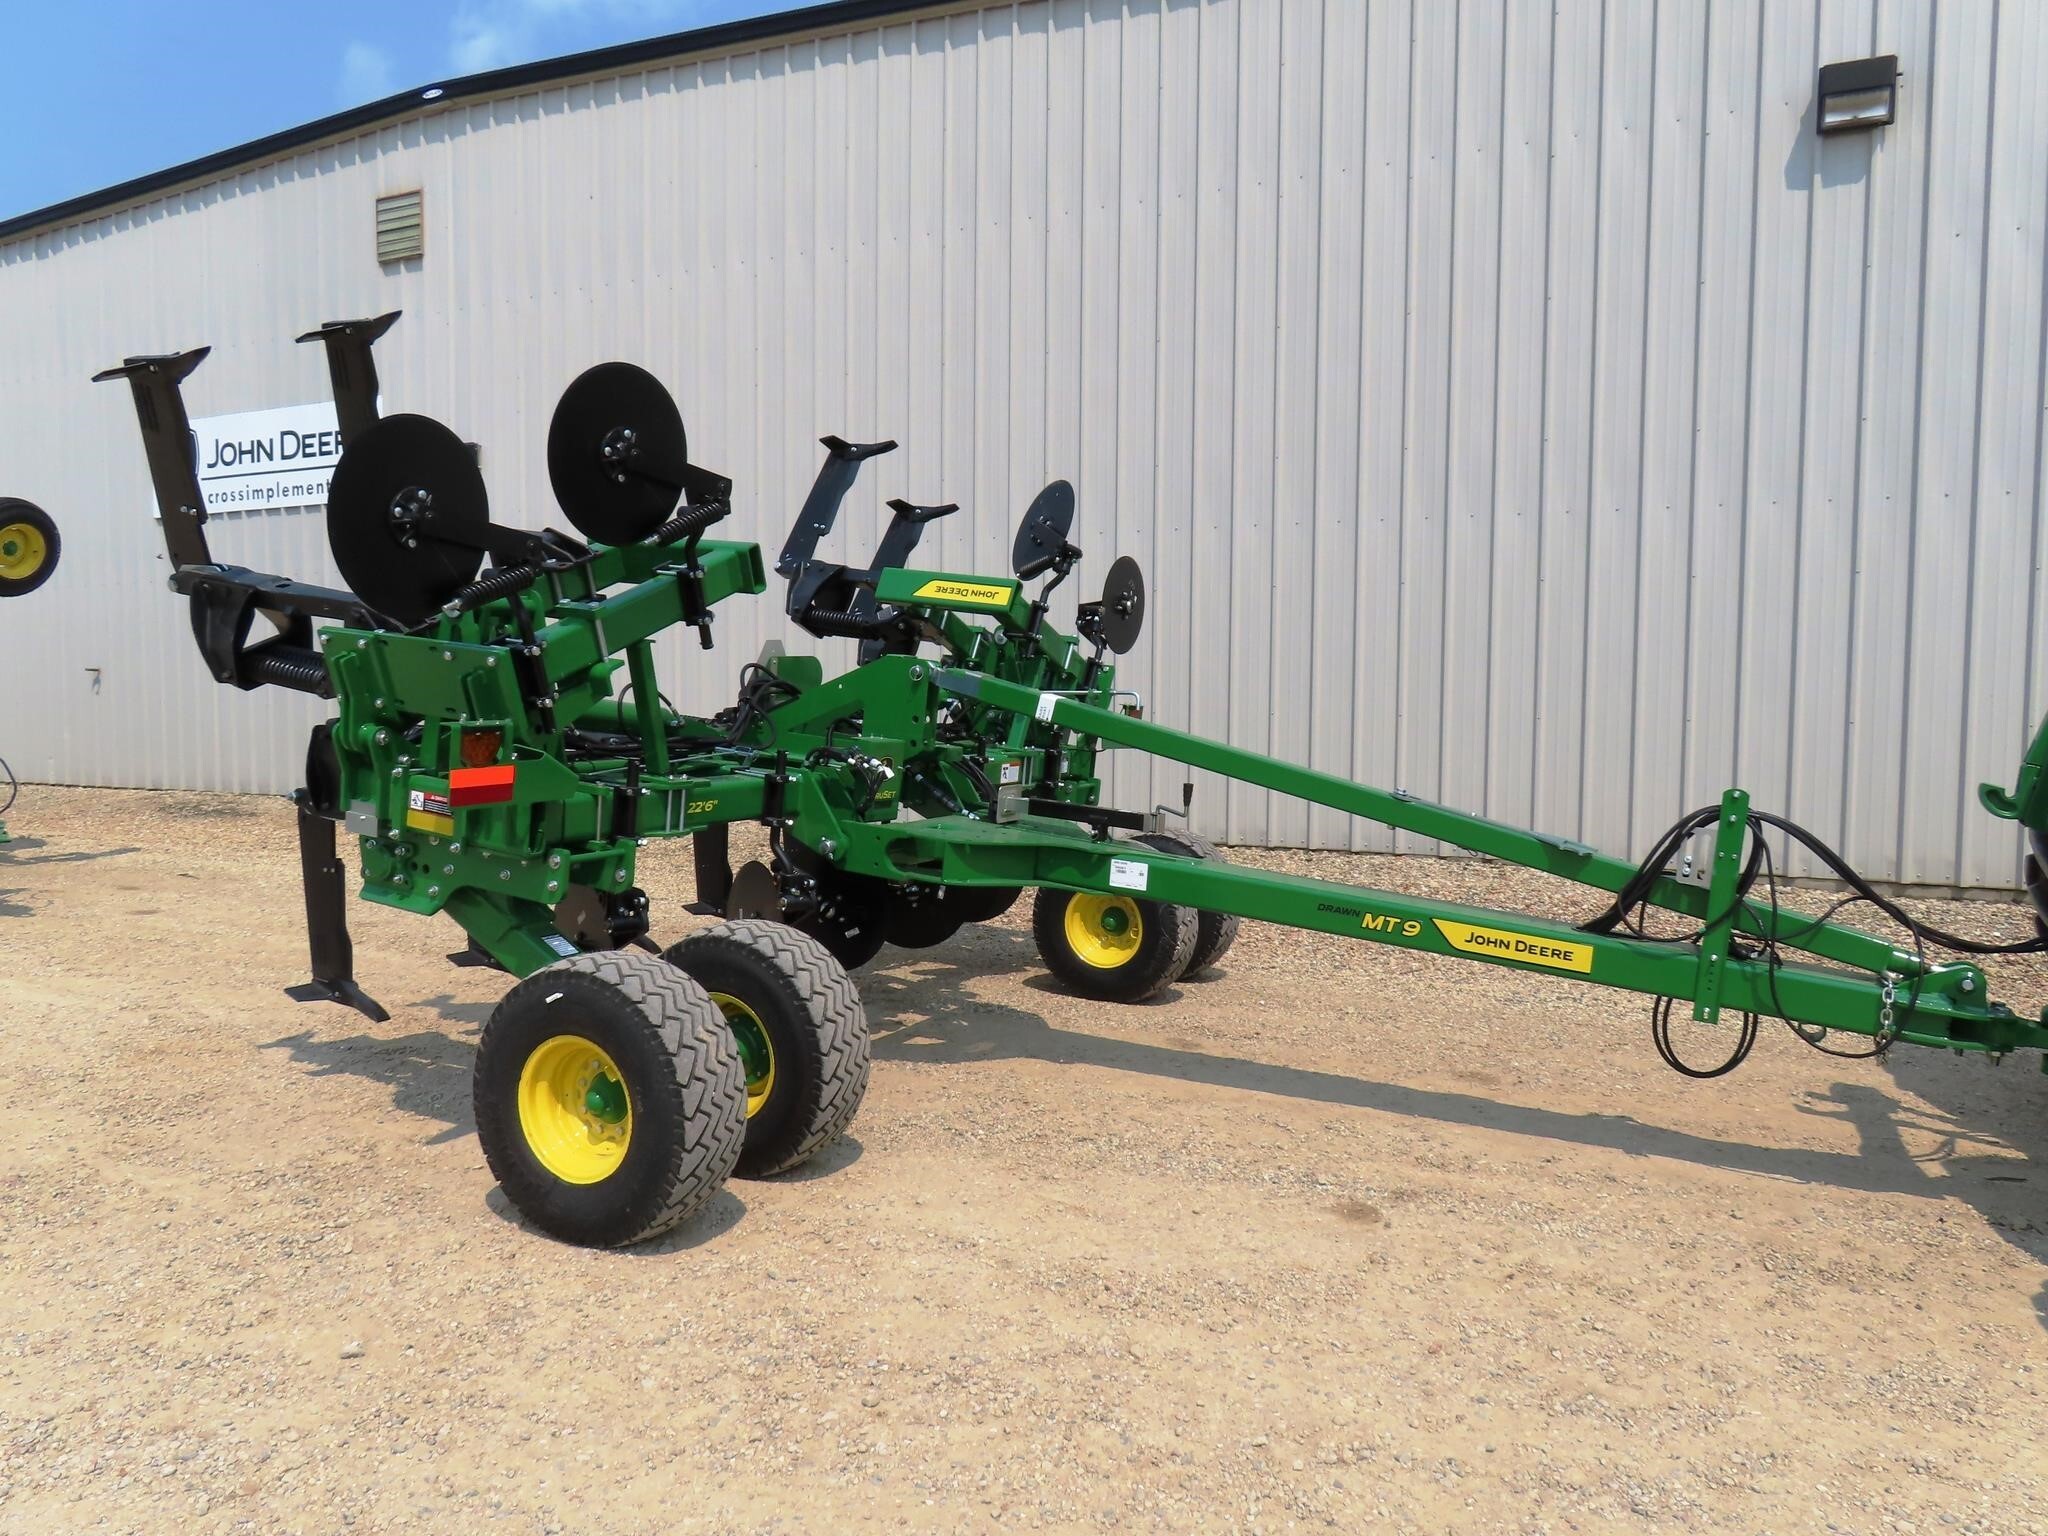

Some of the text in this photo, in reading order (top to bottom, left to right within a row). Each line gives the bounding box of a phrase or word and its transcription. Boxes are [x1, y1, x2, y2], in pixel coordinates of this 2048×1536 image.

[207, 430, 344, 469] JOHN DEER
[208, 479, 331, 504] crossimplement
[934, 585, 1000, 600] JOHN DEERE
[1317, 903, 1360, 917] DRAWN
[1464, 931, 1574, 962] JOHN DEERE
